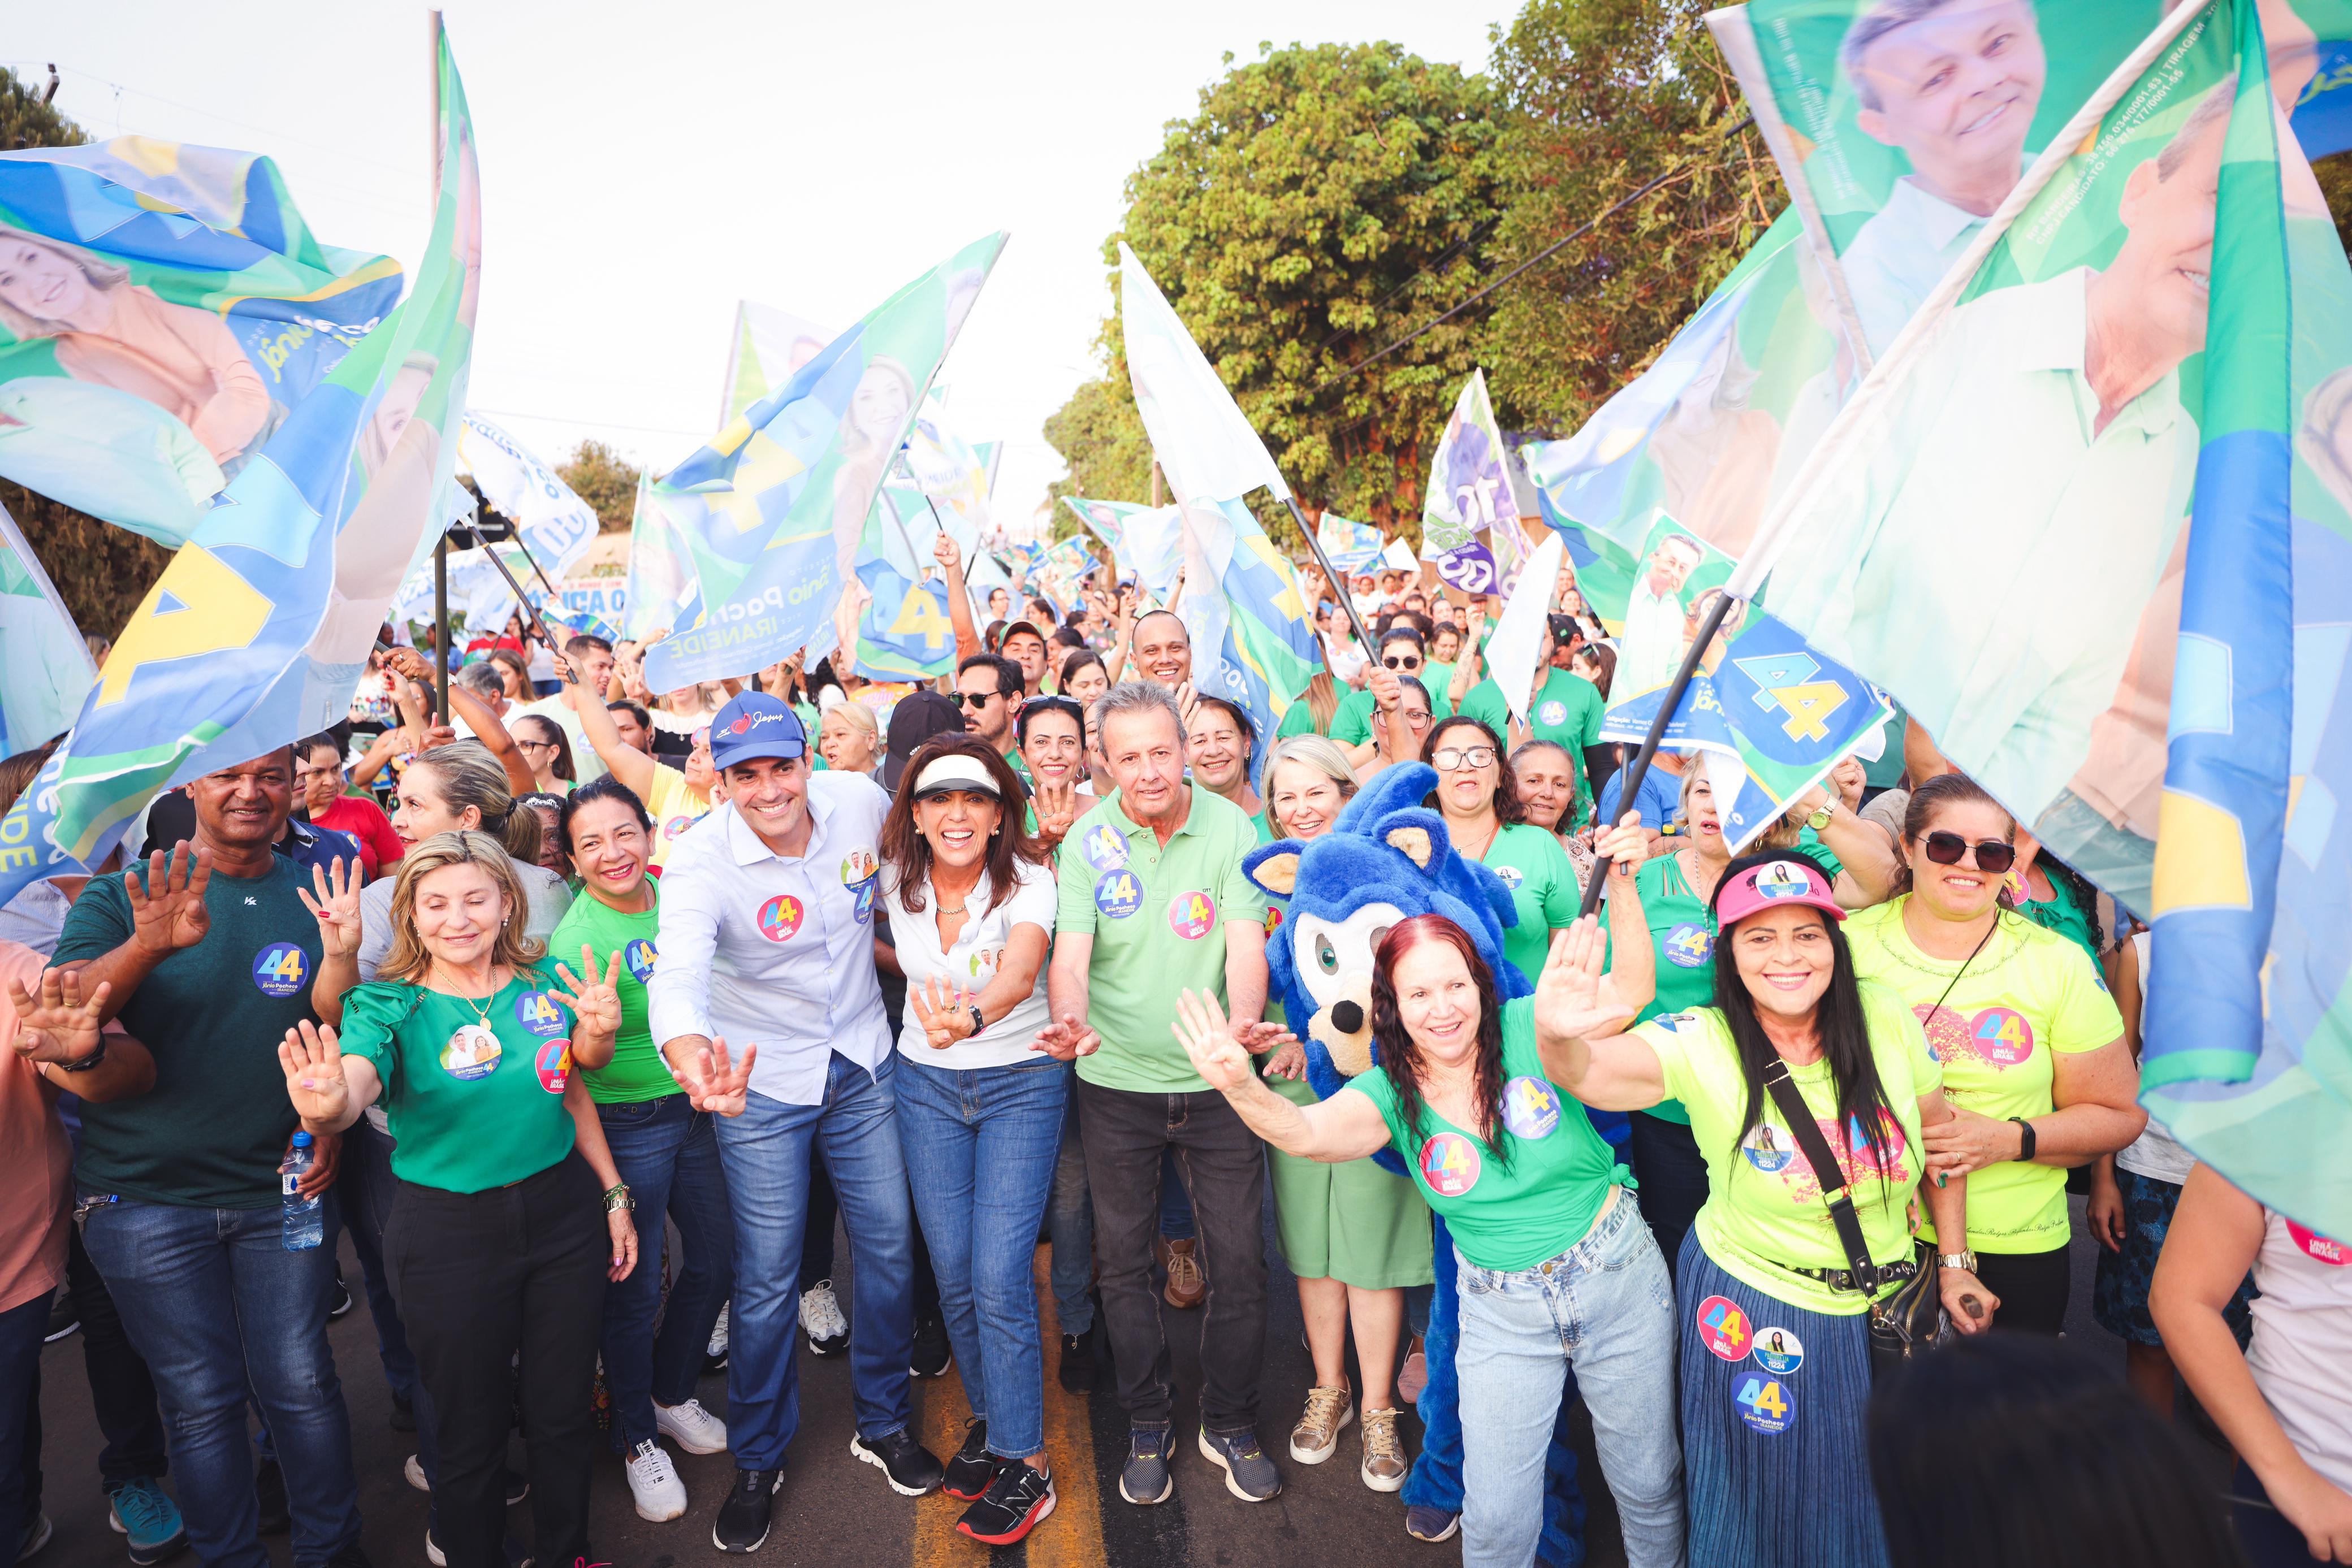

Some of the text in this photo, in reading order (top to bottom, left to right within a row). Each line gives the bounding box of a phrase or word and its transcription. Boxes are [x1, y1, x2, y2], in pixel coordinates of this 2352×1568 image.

[2162, 21, 2206, 70] TIRAGEM
[1732, 651, 1850, 743] 44
[751, 711, 784, 730] Jesus
[1089, 826, 1122, 863] 44
[1099, 874, 1138, 905] 44
[763, 897, 798, 929] 44
[1175, 895, 1209, 926] 44
[631, 941, 659, 972] 44
[1667, 926, 1708, 956] 44
[257, 949, 304, 982] 44
[522, 994, 560, 1024] 44
[1976, 1014, 2026, 1049] 44
[482, 1062, 494, 1072] 44
[541, 1045, 573, 1077] 44
[1507, 1078, 1551, 1128] 44
[1426, 1139, 1472, 1177] 44
[1757, 1159, 1776, 1169] 11224
[1702, 1303, 1745, 1346] 44
[1767, 1360, 1785, 1371] 11224
[1736, 1378, 1787, 1419] 44
[1744, 1413, 1784, 1427] Jânio Pacheco
[1759, 1422, 1783, 1431] IRANEIDE
